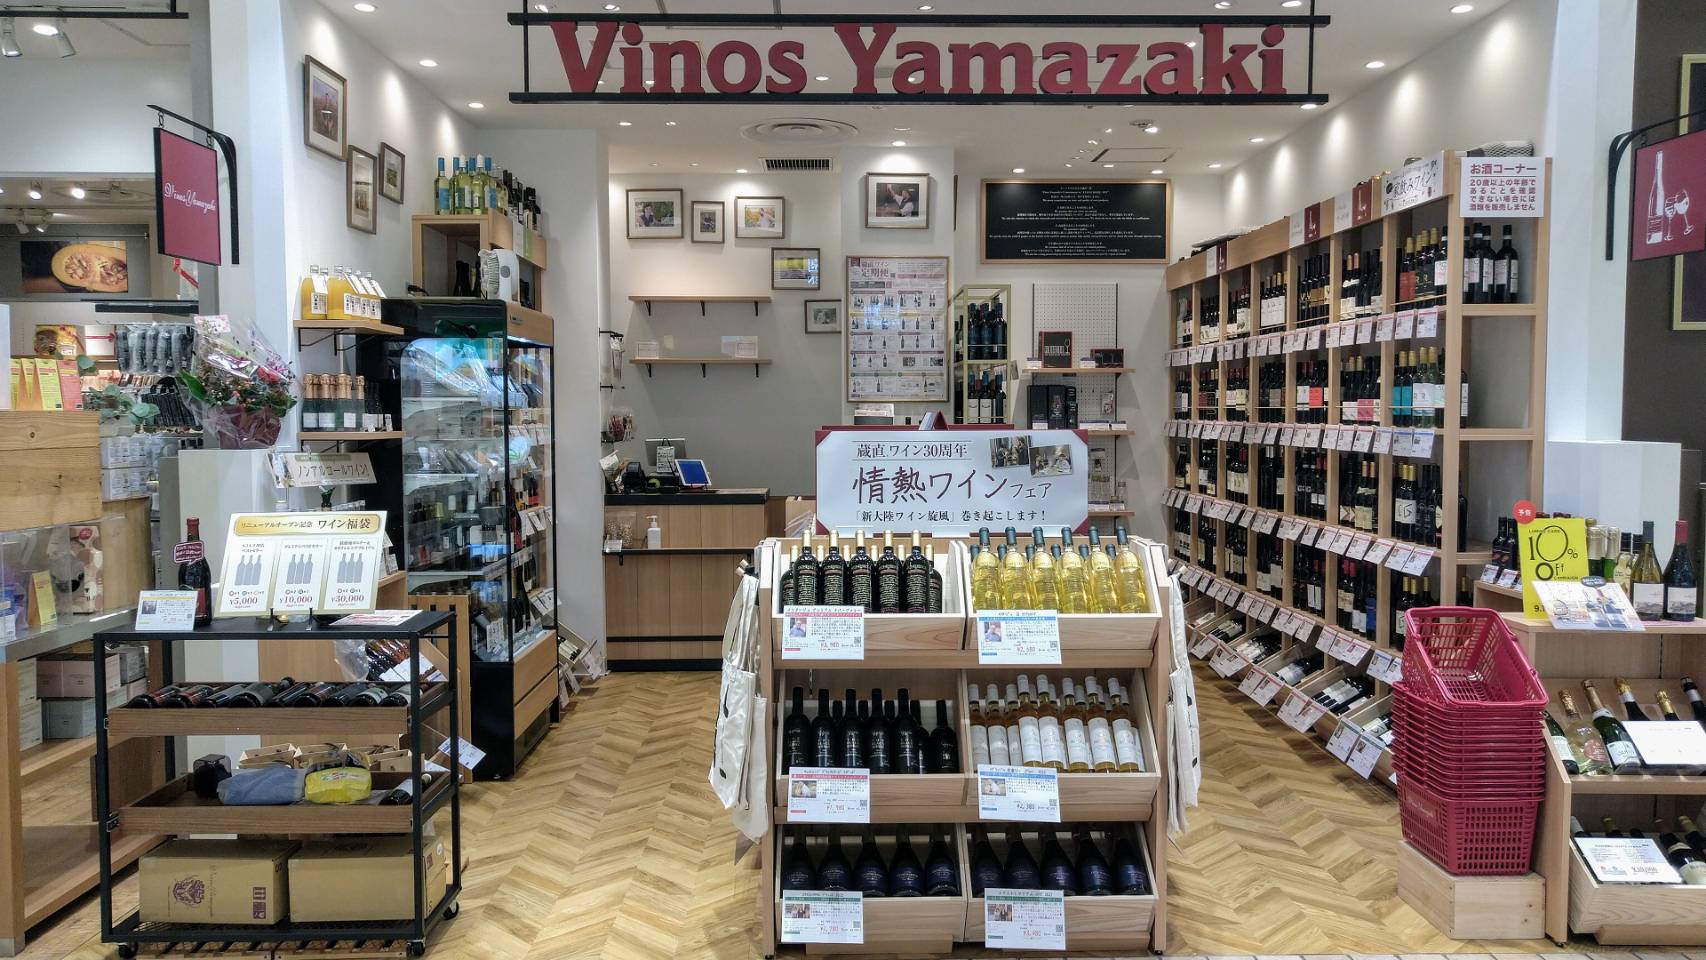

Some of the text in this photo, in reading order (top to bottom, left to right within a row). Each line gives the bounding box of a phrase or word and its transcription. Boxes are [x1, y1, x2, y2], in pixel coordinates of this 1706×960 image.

[551, 21, 1287, 96] Vinos Yamazaki
[1470, 163, 1537, 174] お酒コーナー
[1470, 178, 1536, 186] 20歳以上の年齢で
[1470, 203, 1536, 211] 酒類を販売しません
[856, 443, 968, 459] 蔵直ワイン30周年
[318, 518, 371, 530] ワイン福袋
[229, 597, 258, 605] ¥5,000
[280, 596, 313, 604] ¥10,000
